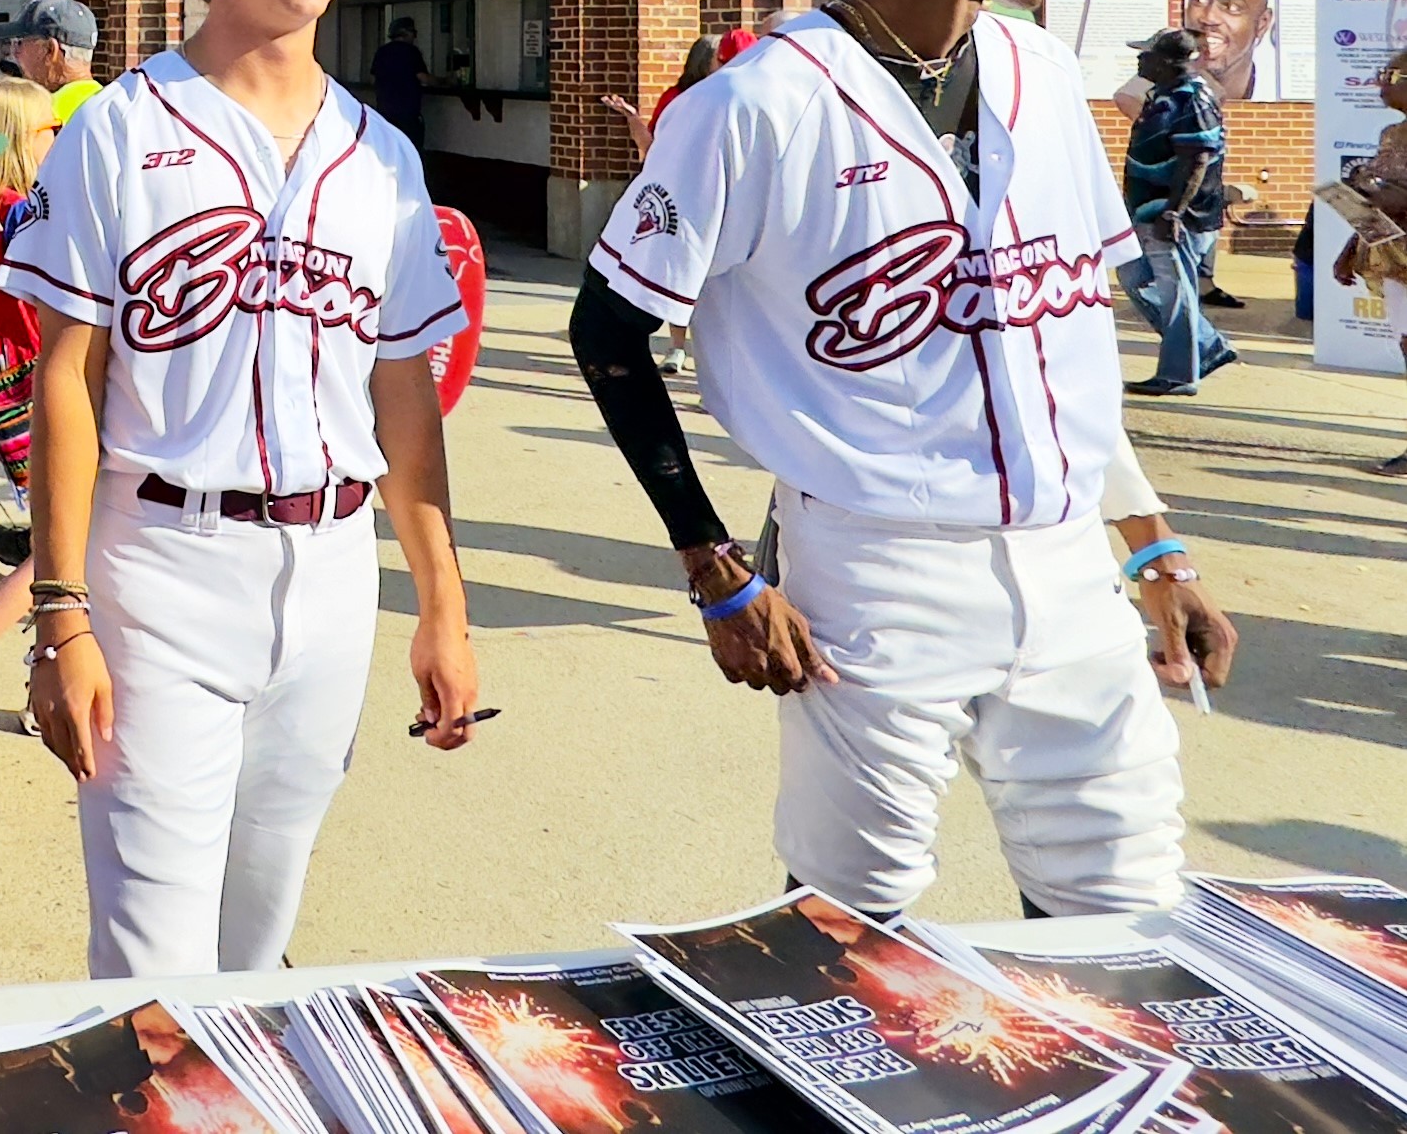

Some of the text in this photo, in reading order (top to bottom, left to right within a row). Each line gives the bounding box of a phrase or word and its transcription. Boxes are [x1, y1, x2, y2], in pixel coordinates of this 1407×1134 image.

[250, 237, 352, 278] MACON
[955, 235, 1057, 280] MACON
[119, 206, 382, 353] Bacon
[805, 220, 1113, 373] Bacon
[599, 1006, 703, 1041] FRESH
[1140, 995, 1255, 1023] FRESH
[618, 1027, 728, 1061] OFF THE
[835, 1026, 886, 1054] OFF
[1167, 1015, 1283, 1043] OFF THE
[617, 1046, 758, 1091] SKILLET
[810, 1048, 918, 1085] FRESH
[1172, 1035, 1323, 1071] SKILLET
